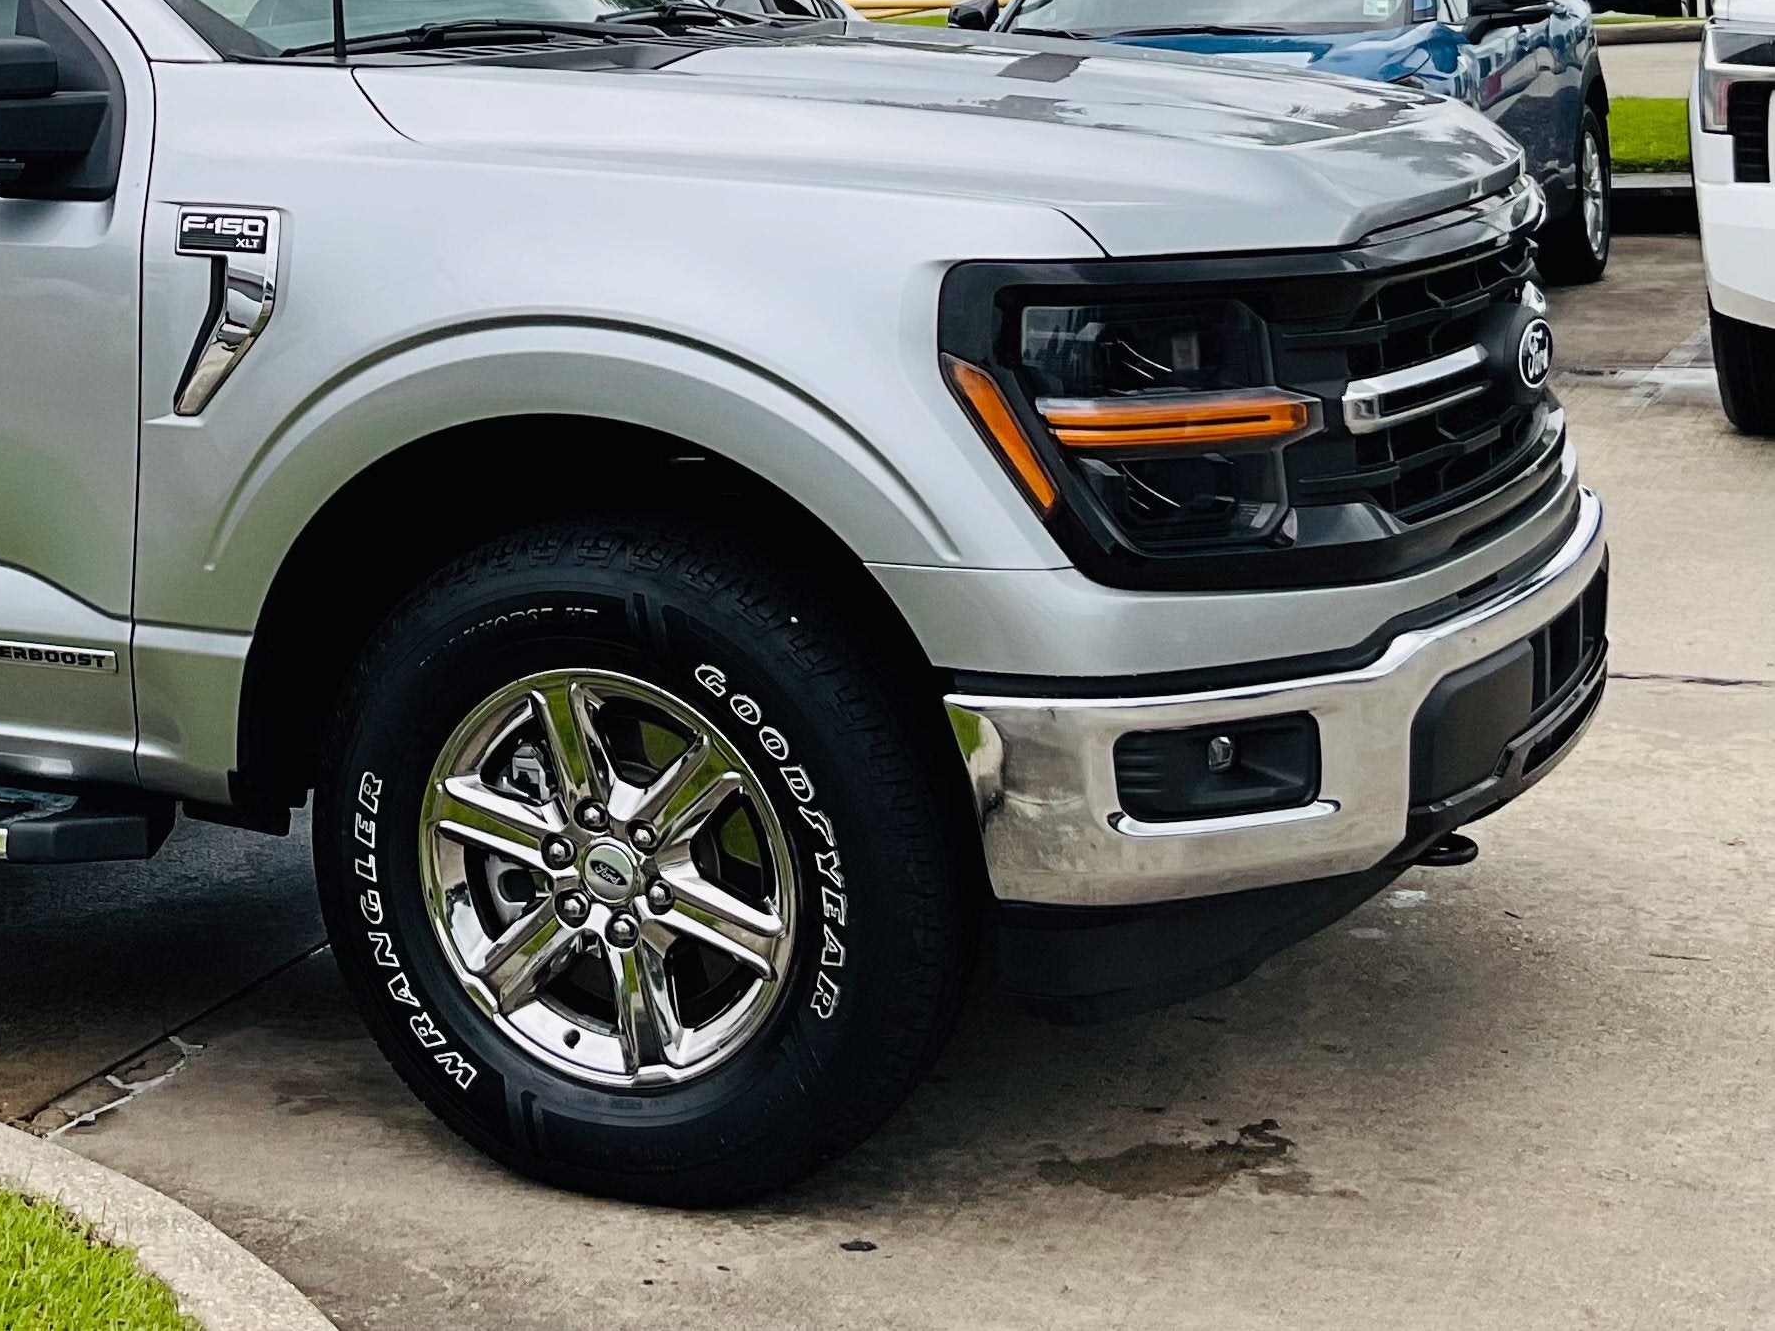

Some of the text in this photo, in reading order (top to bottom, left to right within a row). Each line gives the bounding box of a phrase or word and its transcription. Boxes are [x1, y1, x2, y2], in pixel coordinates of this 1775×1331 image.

[182, 215, 266, 237] F-150
[235, 238, 261, 249] XLT
[694, 663, 849, 1019] GOODYEAR
[594, 863, 622, 885] Ford
[354, 771, 478, 1090] WRANGLER
